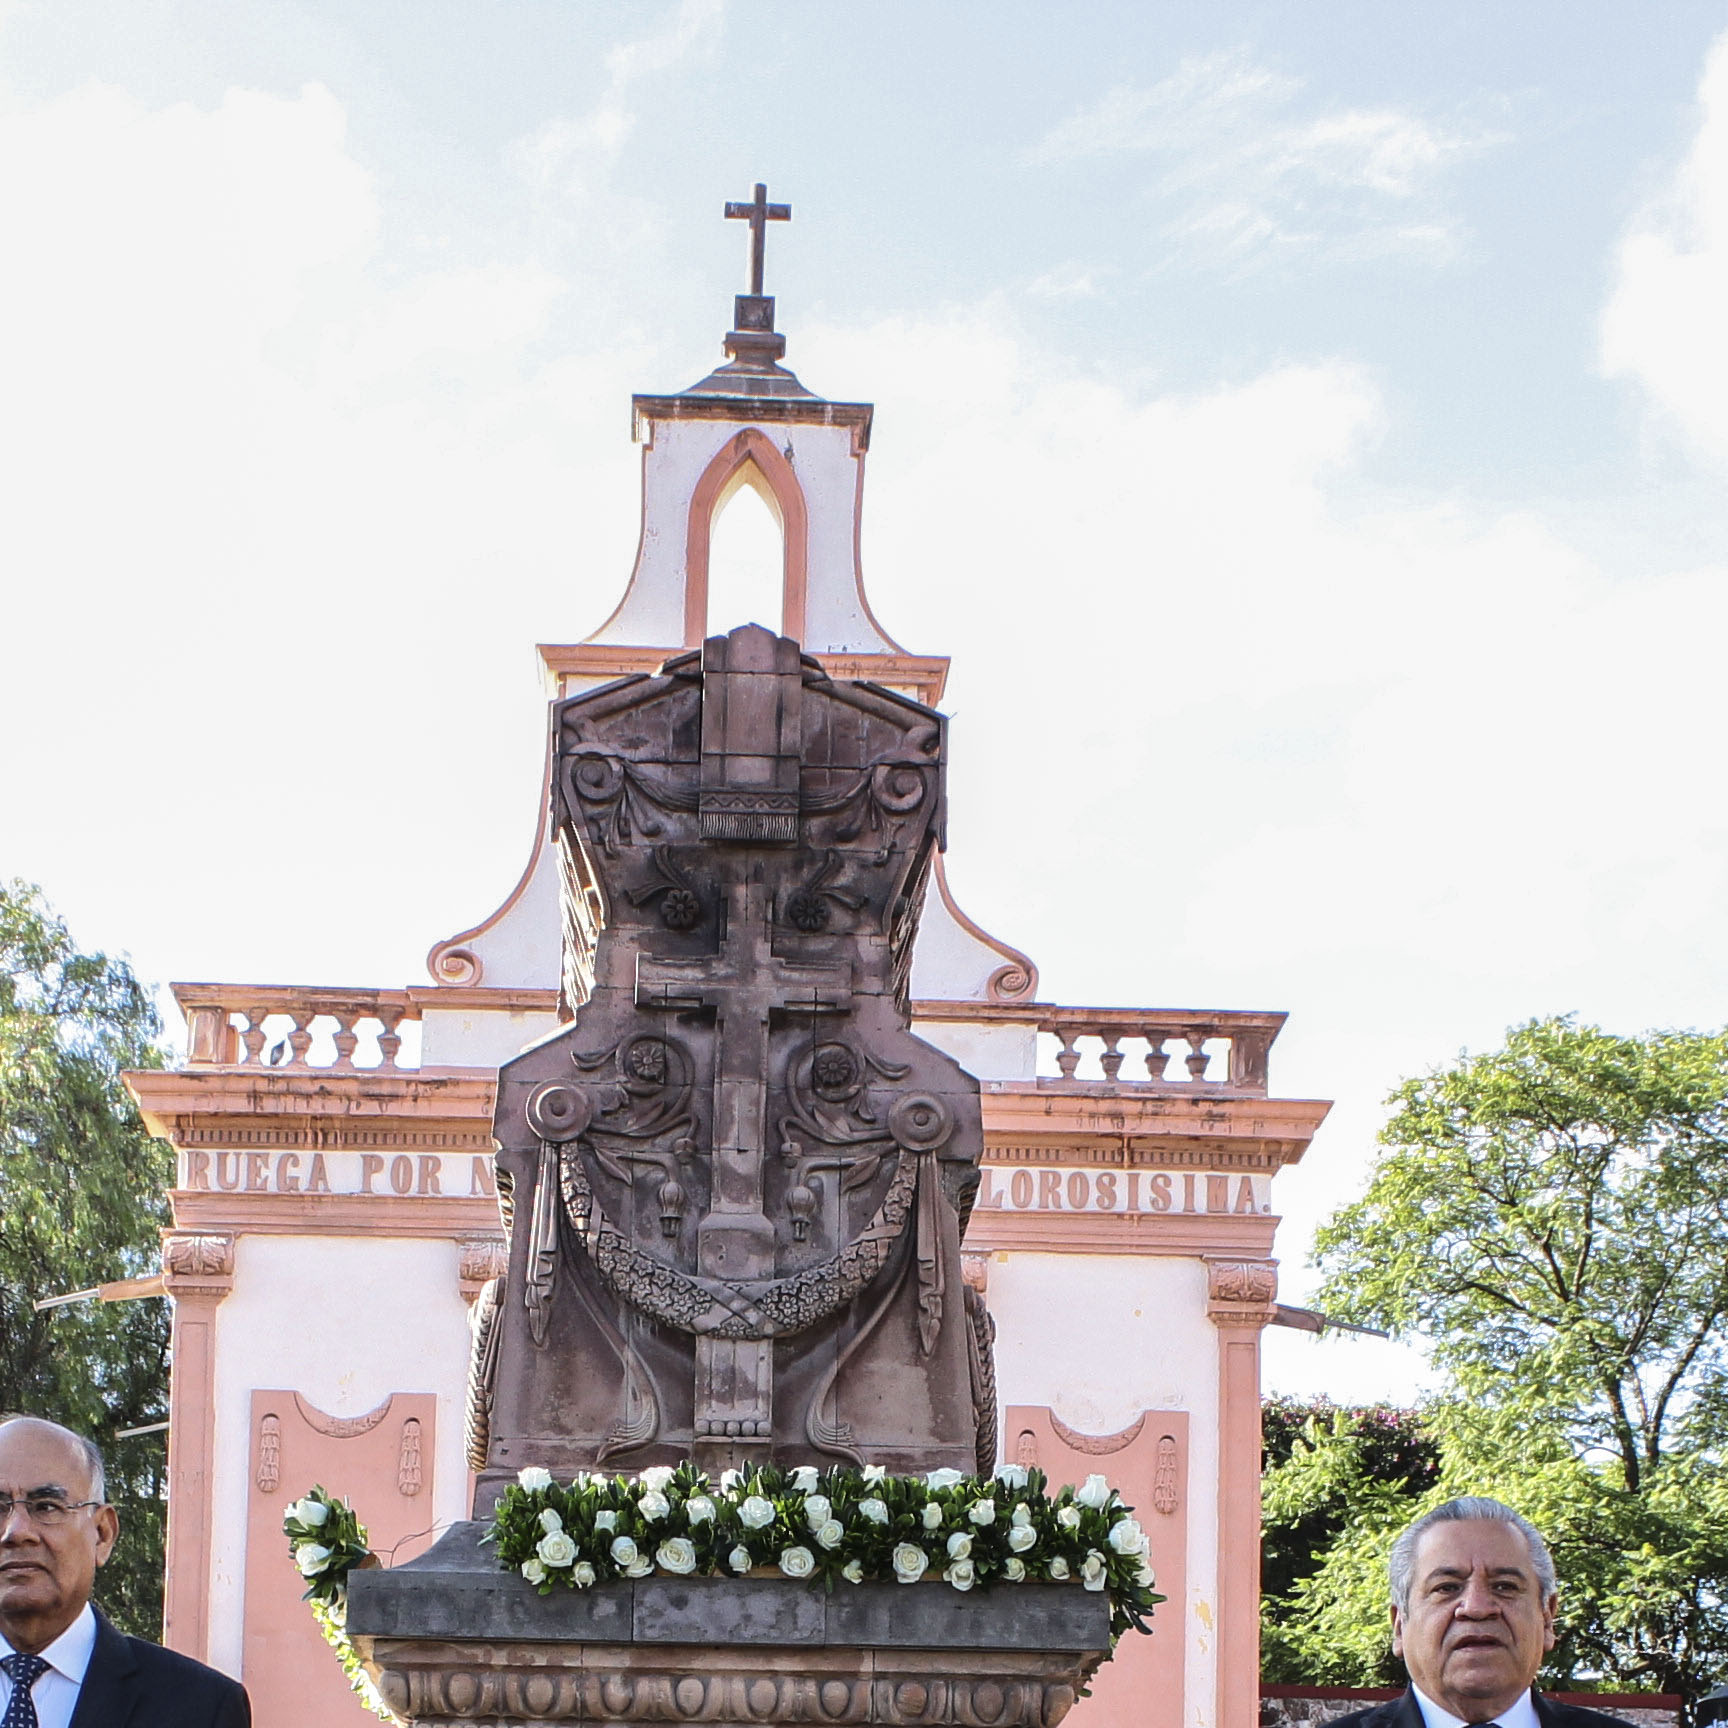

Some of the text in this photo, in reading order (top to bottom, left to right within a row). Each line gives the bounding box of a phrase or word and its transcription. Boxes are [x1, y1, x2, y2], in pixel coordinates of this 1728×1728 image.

[187, 1150, 331, 1193] RUEGA
[360, 1153, 443, 1195] POR
[980, 1168, 1270, 1214] LOROSISIMA.
